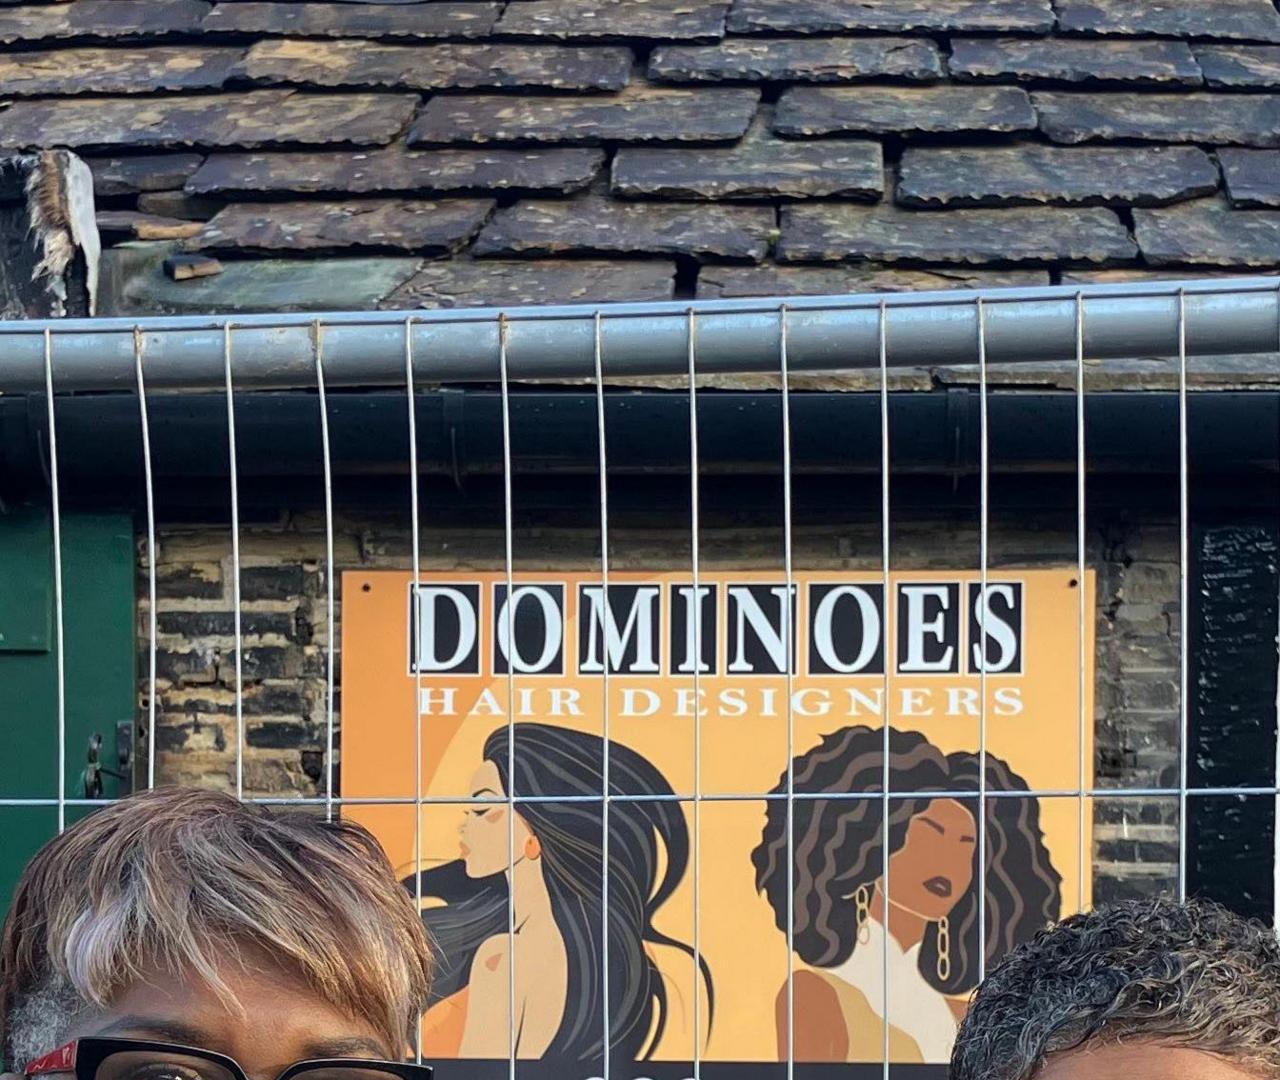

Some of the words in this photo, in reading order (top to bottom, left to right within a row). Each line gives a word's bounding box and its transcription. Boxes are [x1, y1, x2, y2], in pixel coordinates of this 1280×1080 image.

[411, 584, 1019, 674] DOMINOES
[420, 687, 583, 716] HAIR
[620, 686, 1025, 716] DESIGNERS
